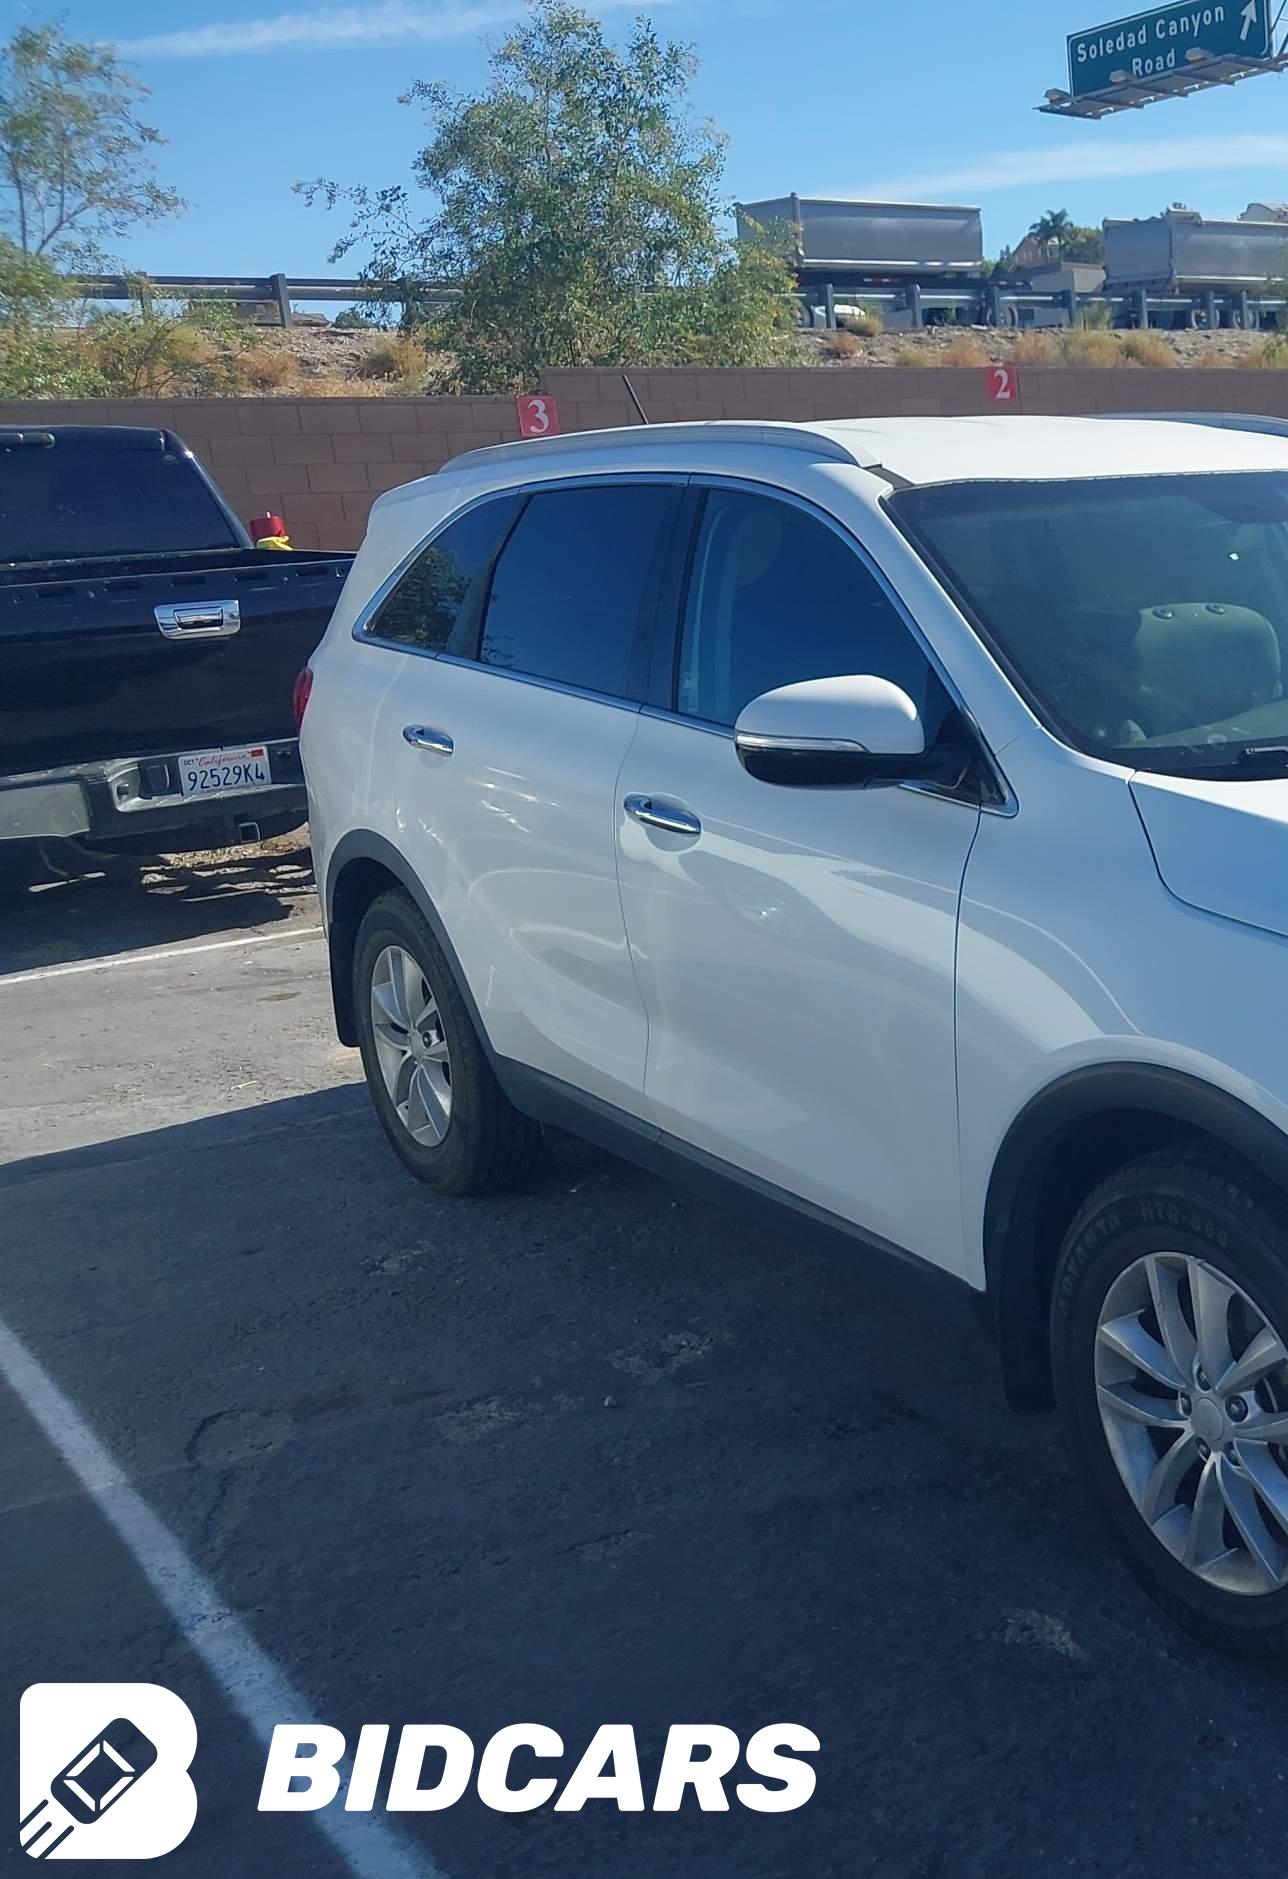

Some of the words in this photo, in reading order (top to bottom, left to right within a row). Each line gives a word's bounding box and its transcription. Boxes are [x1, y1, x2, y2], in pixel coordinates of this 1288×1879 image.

[1077, 24, 1147, 63] Soledad
[1156, 6, 1225, 39] Canyon
[1132, 48, 1176, 76] Road
[993, 369, 1010, 399] 2
[528, 399, 549, 432] 3
[198, 753, 246, 767] California
[187, 762, 265, 791] 92529K4
